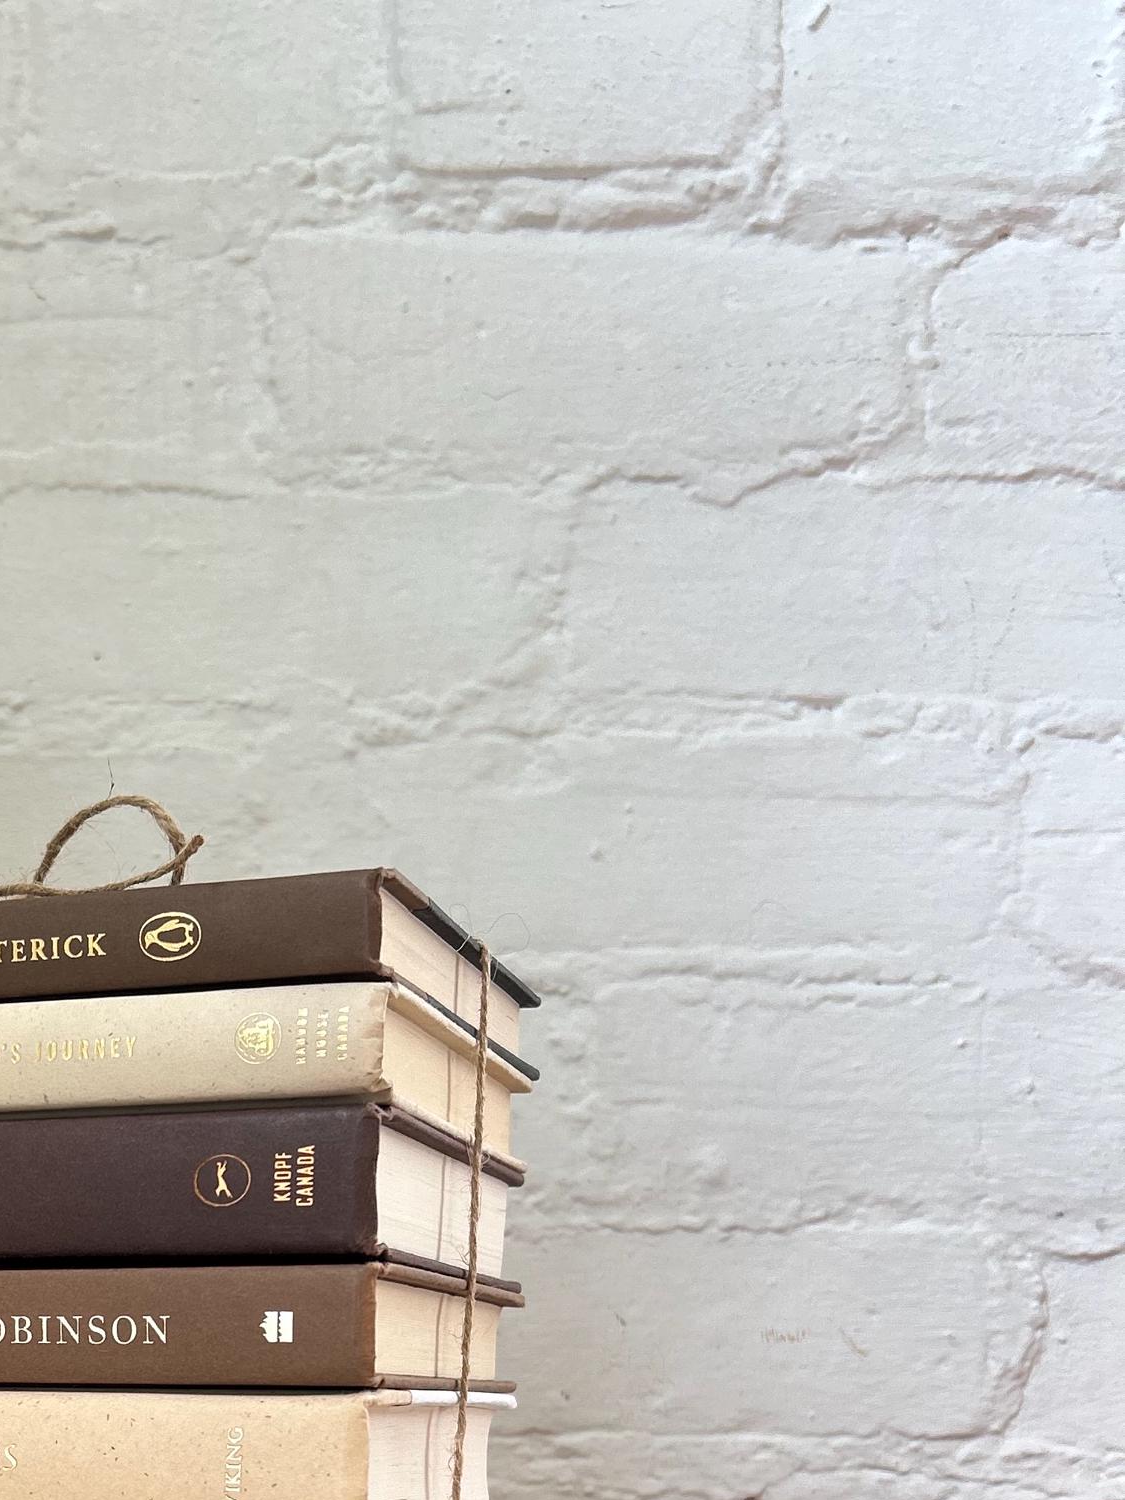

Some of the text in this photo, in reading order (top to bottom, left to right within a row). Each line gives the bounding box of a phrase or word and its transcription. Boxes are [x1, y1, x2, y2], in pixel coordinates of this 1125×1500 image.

[35, 1035, 137, 1062] JOURNEY
[273, 1152, 293, 1202] KNOPF
[295, 1144, 316, 1207] CANADA
